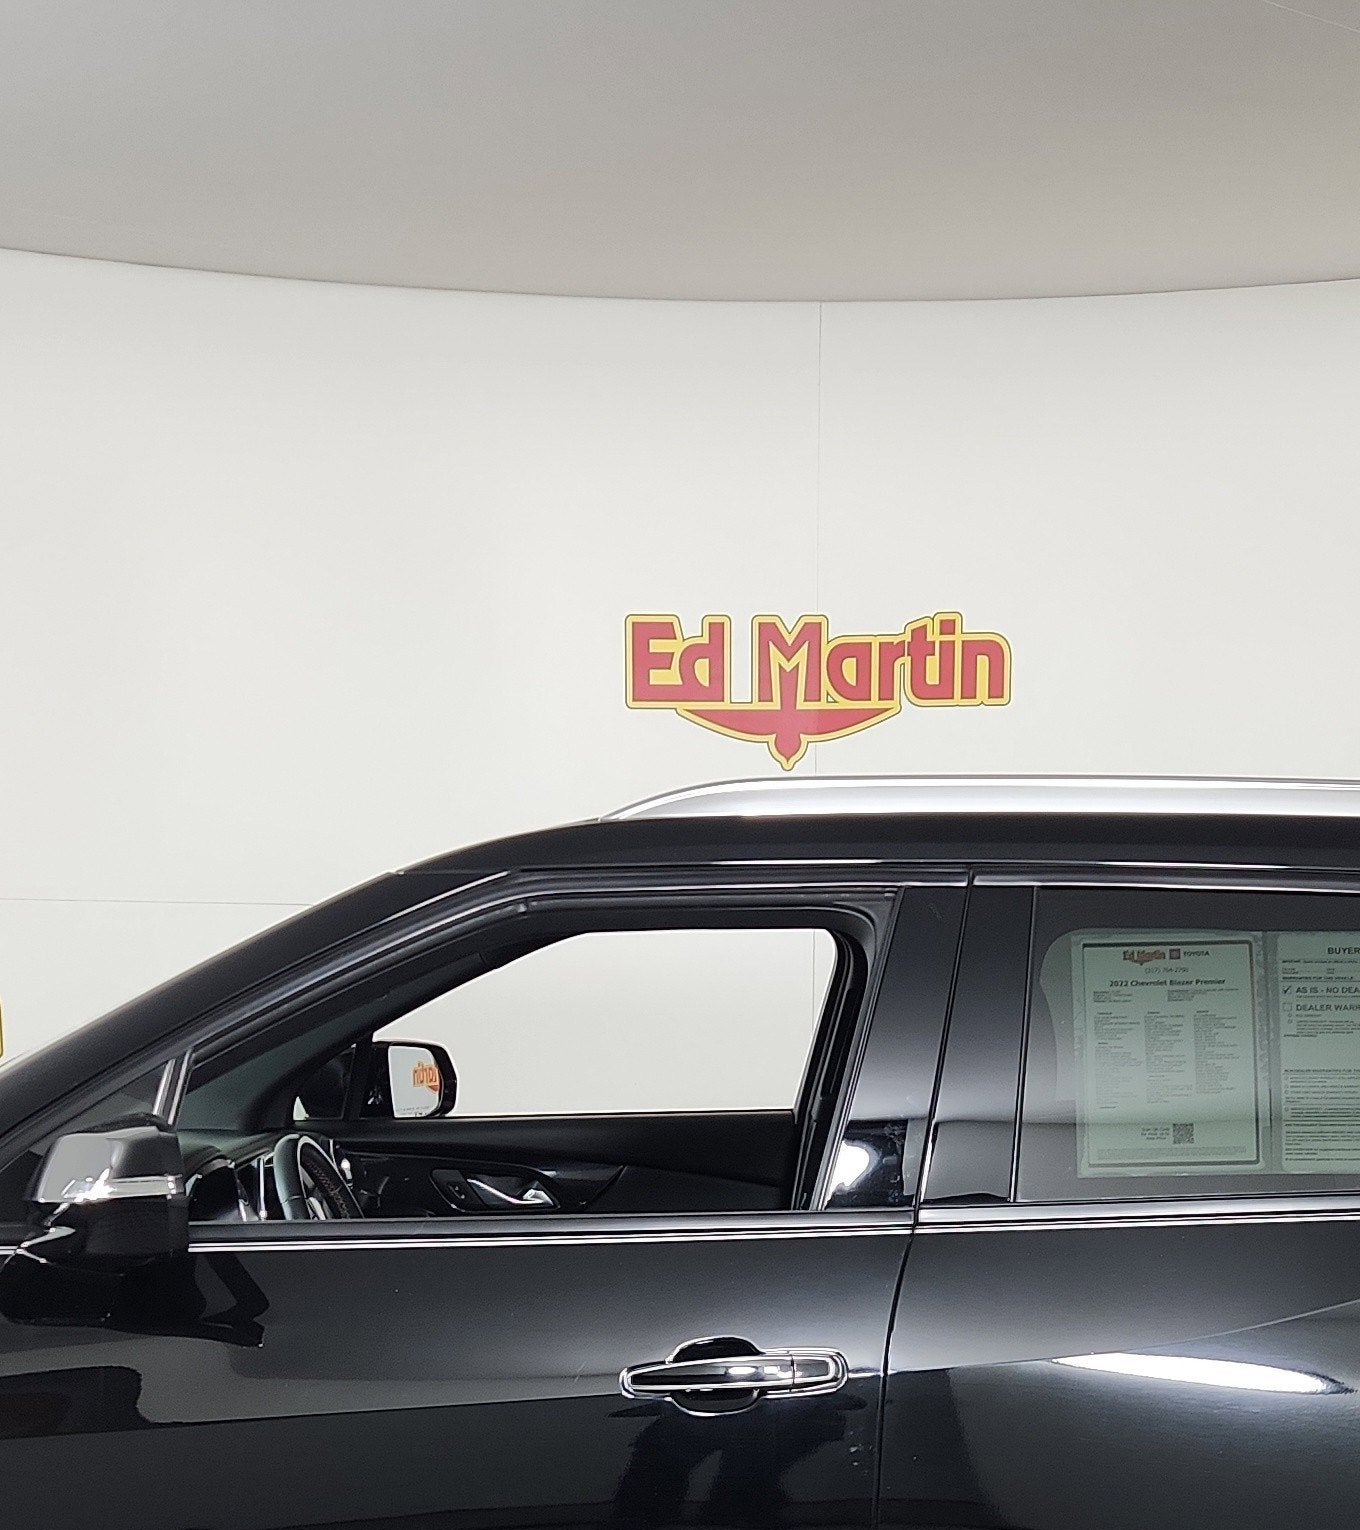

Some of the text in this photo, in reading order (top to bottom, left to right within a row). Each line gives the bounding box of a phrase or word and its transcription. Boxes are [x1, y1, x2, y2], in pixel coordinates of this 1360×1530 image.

[625, 612, 1012, 712] Ed Martin
[1295, 986, 1308, 994] AS
[1309, 986, 1319, 994] IS
[1326, 986, 1339, 994] NO
[1295, 1003, 1332, 1012] DEALER
